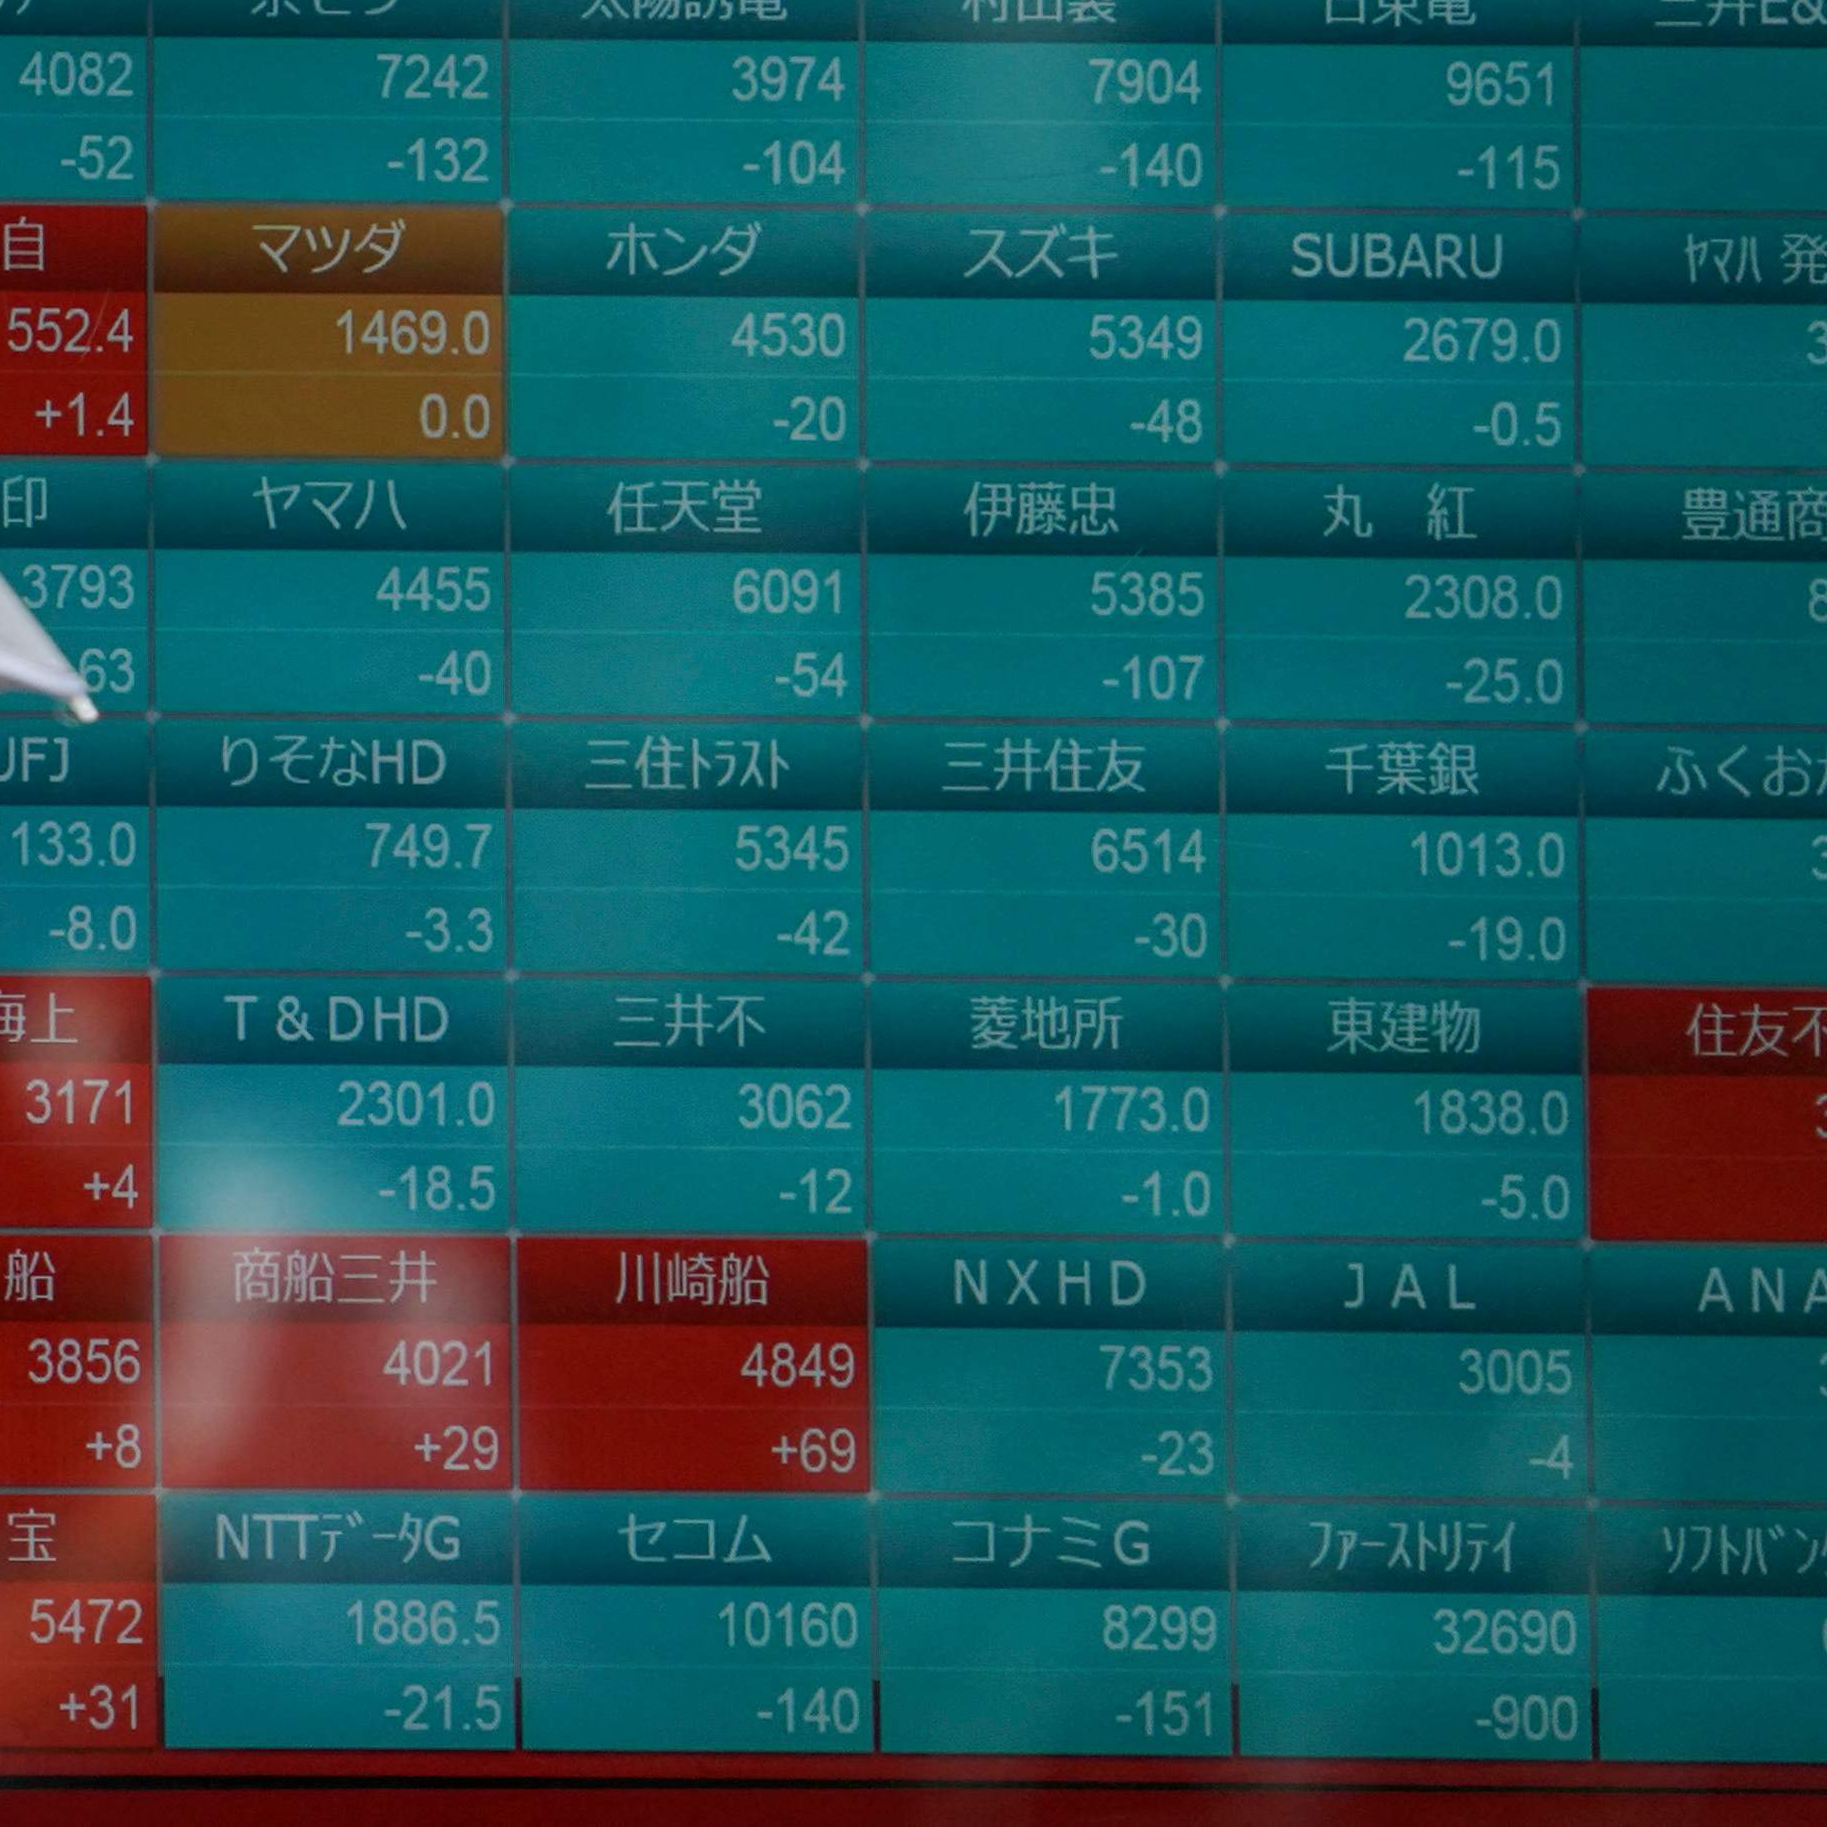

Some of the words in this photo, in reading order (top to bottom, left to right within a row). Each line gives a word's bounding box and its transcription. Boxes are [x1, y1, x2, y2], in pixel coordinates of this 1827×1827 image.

[253, 218, 407, 274] マツダ
[606, 221, 762, 277] ホンダ
[963, 223, 1118, 279] スズキ
[1291, 232, 1503, 279] SUBARU
[7, 306, 135, 356] 552.4
[336, 309, 491, 356] 1469.0
[253, 476, 407, 530] ヤマハ
[607, 478, 763, 535] 任天堂
[963, 481, 1119, 537] 伊藤忠
[221, 734, 447, 787] りそなHD
[942, 737, 1145, 793] 三井住友
[1325, 741, 1479, 795] 千葉銀
[970, 995, 1123, 1050] 菱地所
[615, 1250, 770, 1306] 川崎船
[771, 1427, 857, 1474] +69
[618, 1513, 772, 1563] セコム
[1433, 1608, 1577, 1656] 32690
[59, 1682, 138, 1731] +31
